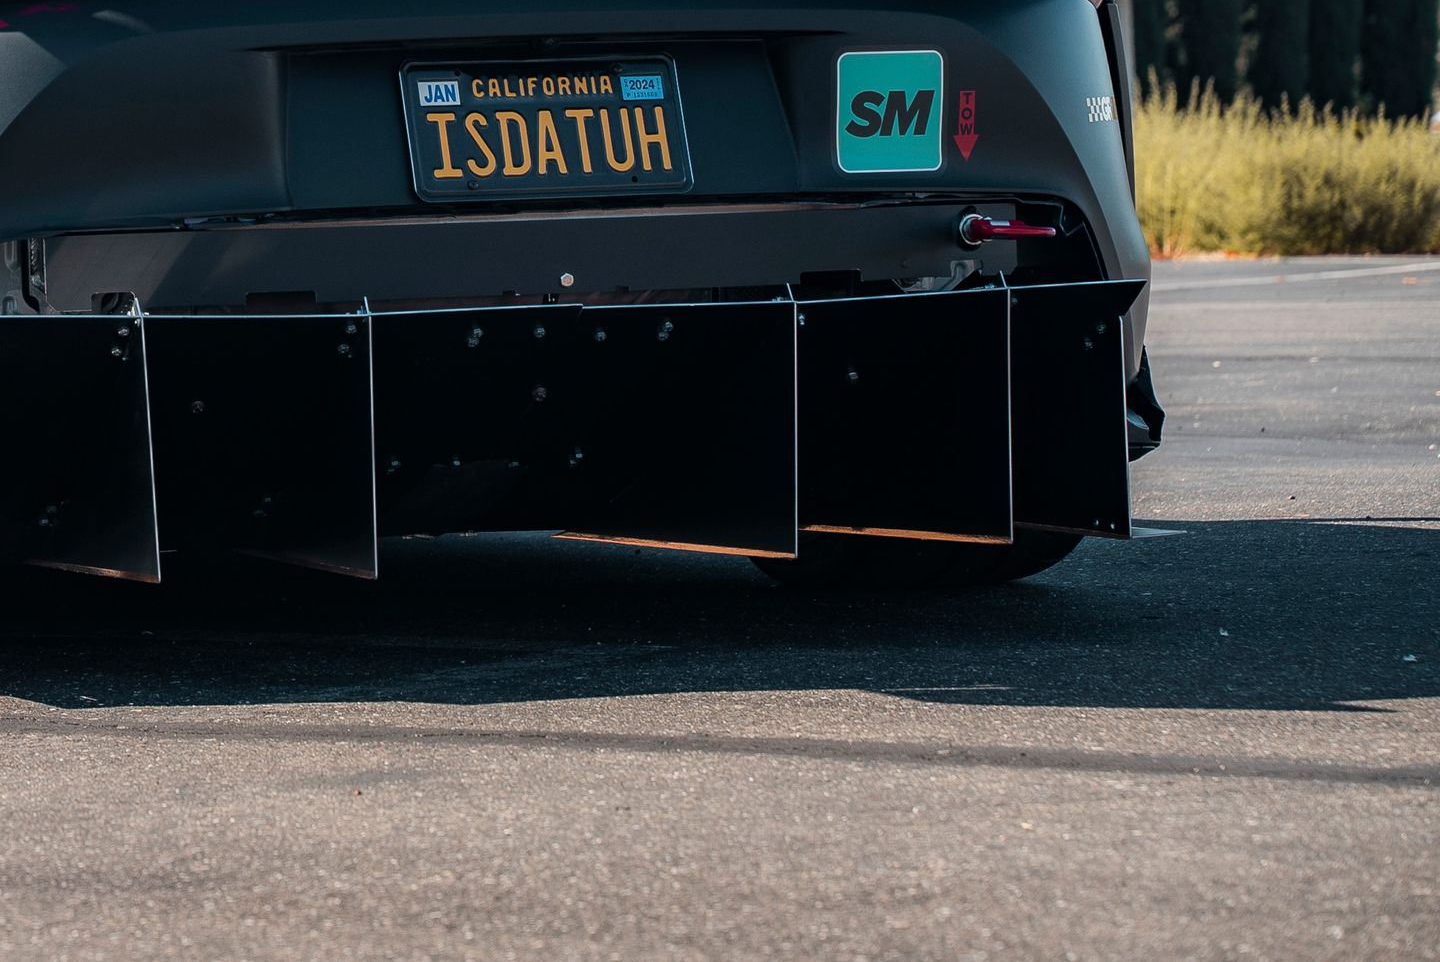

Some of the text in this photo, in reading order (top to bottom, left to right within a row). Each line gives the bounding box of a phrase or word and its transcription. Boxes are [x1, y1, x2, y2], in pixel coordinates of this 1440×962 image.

[424, 83, 457, 104] JAN
[471, 75, 613, 98] CALIFORNIA
[629, 79, 655, 90] 2024
[845, 89, 935, 138] SM
[959, 91, 975, 136] TOW
[425, 105, 673, 179] ISDATUH
